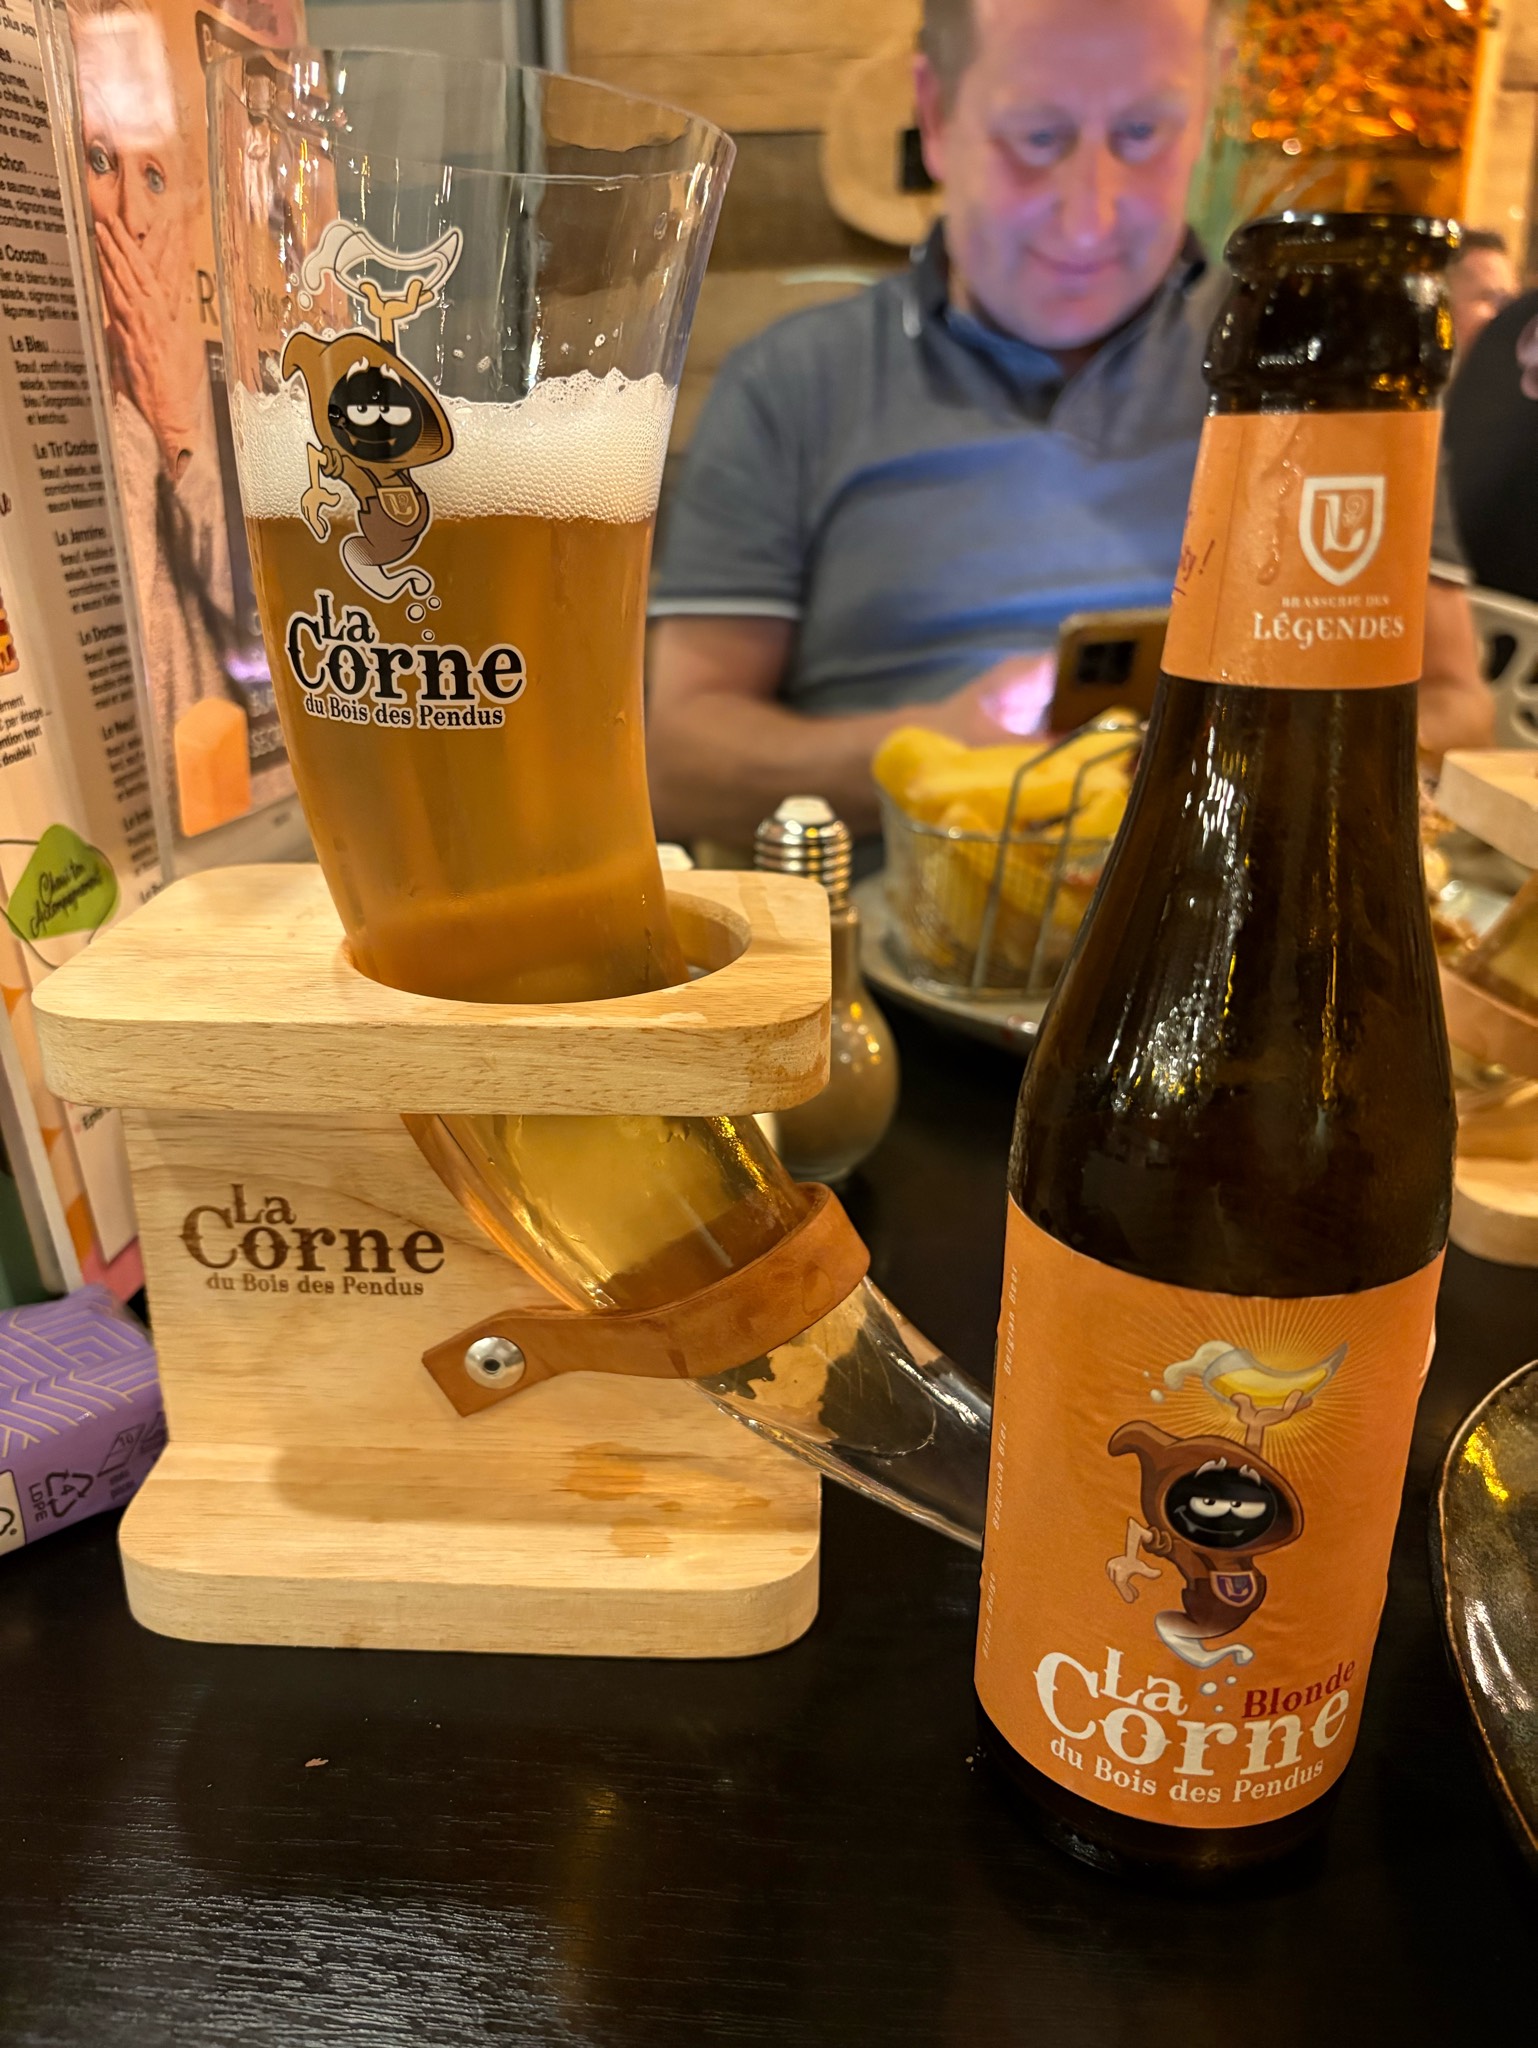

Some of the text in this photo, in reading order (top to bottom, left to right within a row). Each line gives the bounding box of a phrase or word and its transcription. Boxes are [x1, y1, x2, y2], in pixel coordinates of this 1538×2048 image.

[9, 335, 24, 353] Le
[319, 592, 378, 645] La
[286, 614, 524, 702] Corne
[305, 692, 325, 715] du
[329, 696, 369, 722] Bois
[374, 703, 412, 726] des
[419, 704, 503, 727] Pendus
[230, 1183, 297, 1225] La
[178, 1204, 445, 1275] Corne
[206, 1272, 424, 1296] du Bois des Pendus
[1003, 1264, 1018, 1376] Belgian Beer
[28, 1482, 48, 1523] LDPE
[991, 1422, 1008, 1531] Belgisch Bier
[1100, 1646, 1189, 1717] La
[1241, 1658, 1357, 1720] Blonde
[1032, 1652, 1350, 1777] Corne
[1050, 1737, 1324, 1804] du Bois des Pendus
